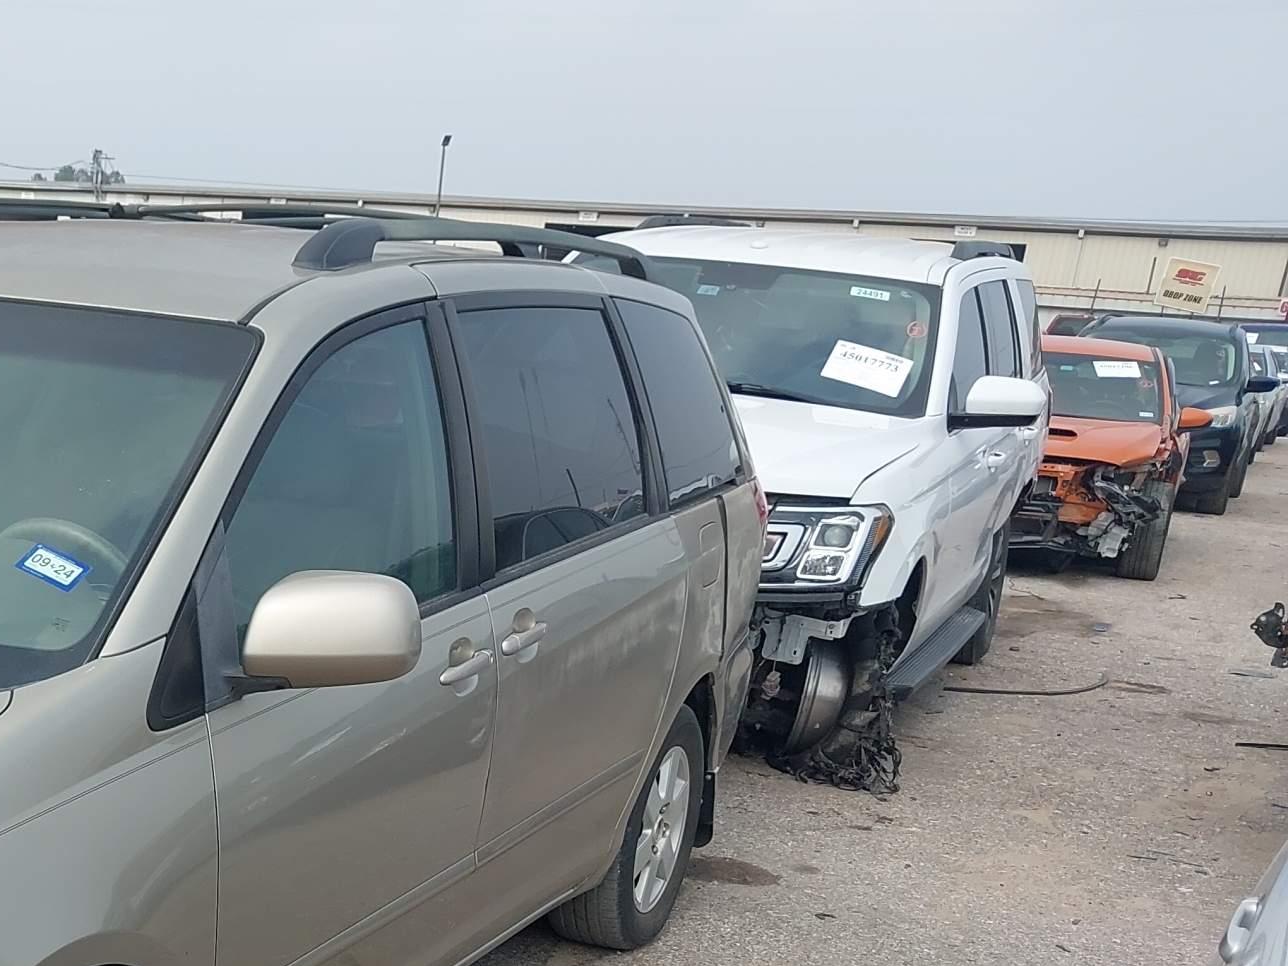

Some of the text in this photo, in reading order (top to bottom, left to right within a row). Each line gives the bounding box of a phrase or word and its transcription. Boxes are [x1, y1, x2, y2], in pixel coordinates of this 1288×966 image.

[1162, 289, 1204, 304] DROP ZONE
[839, 350, 899, 373] 45017773
